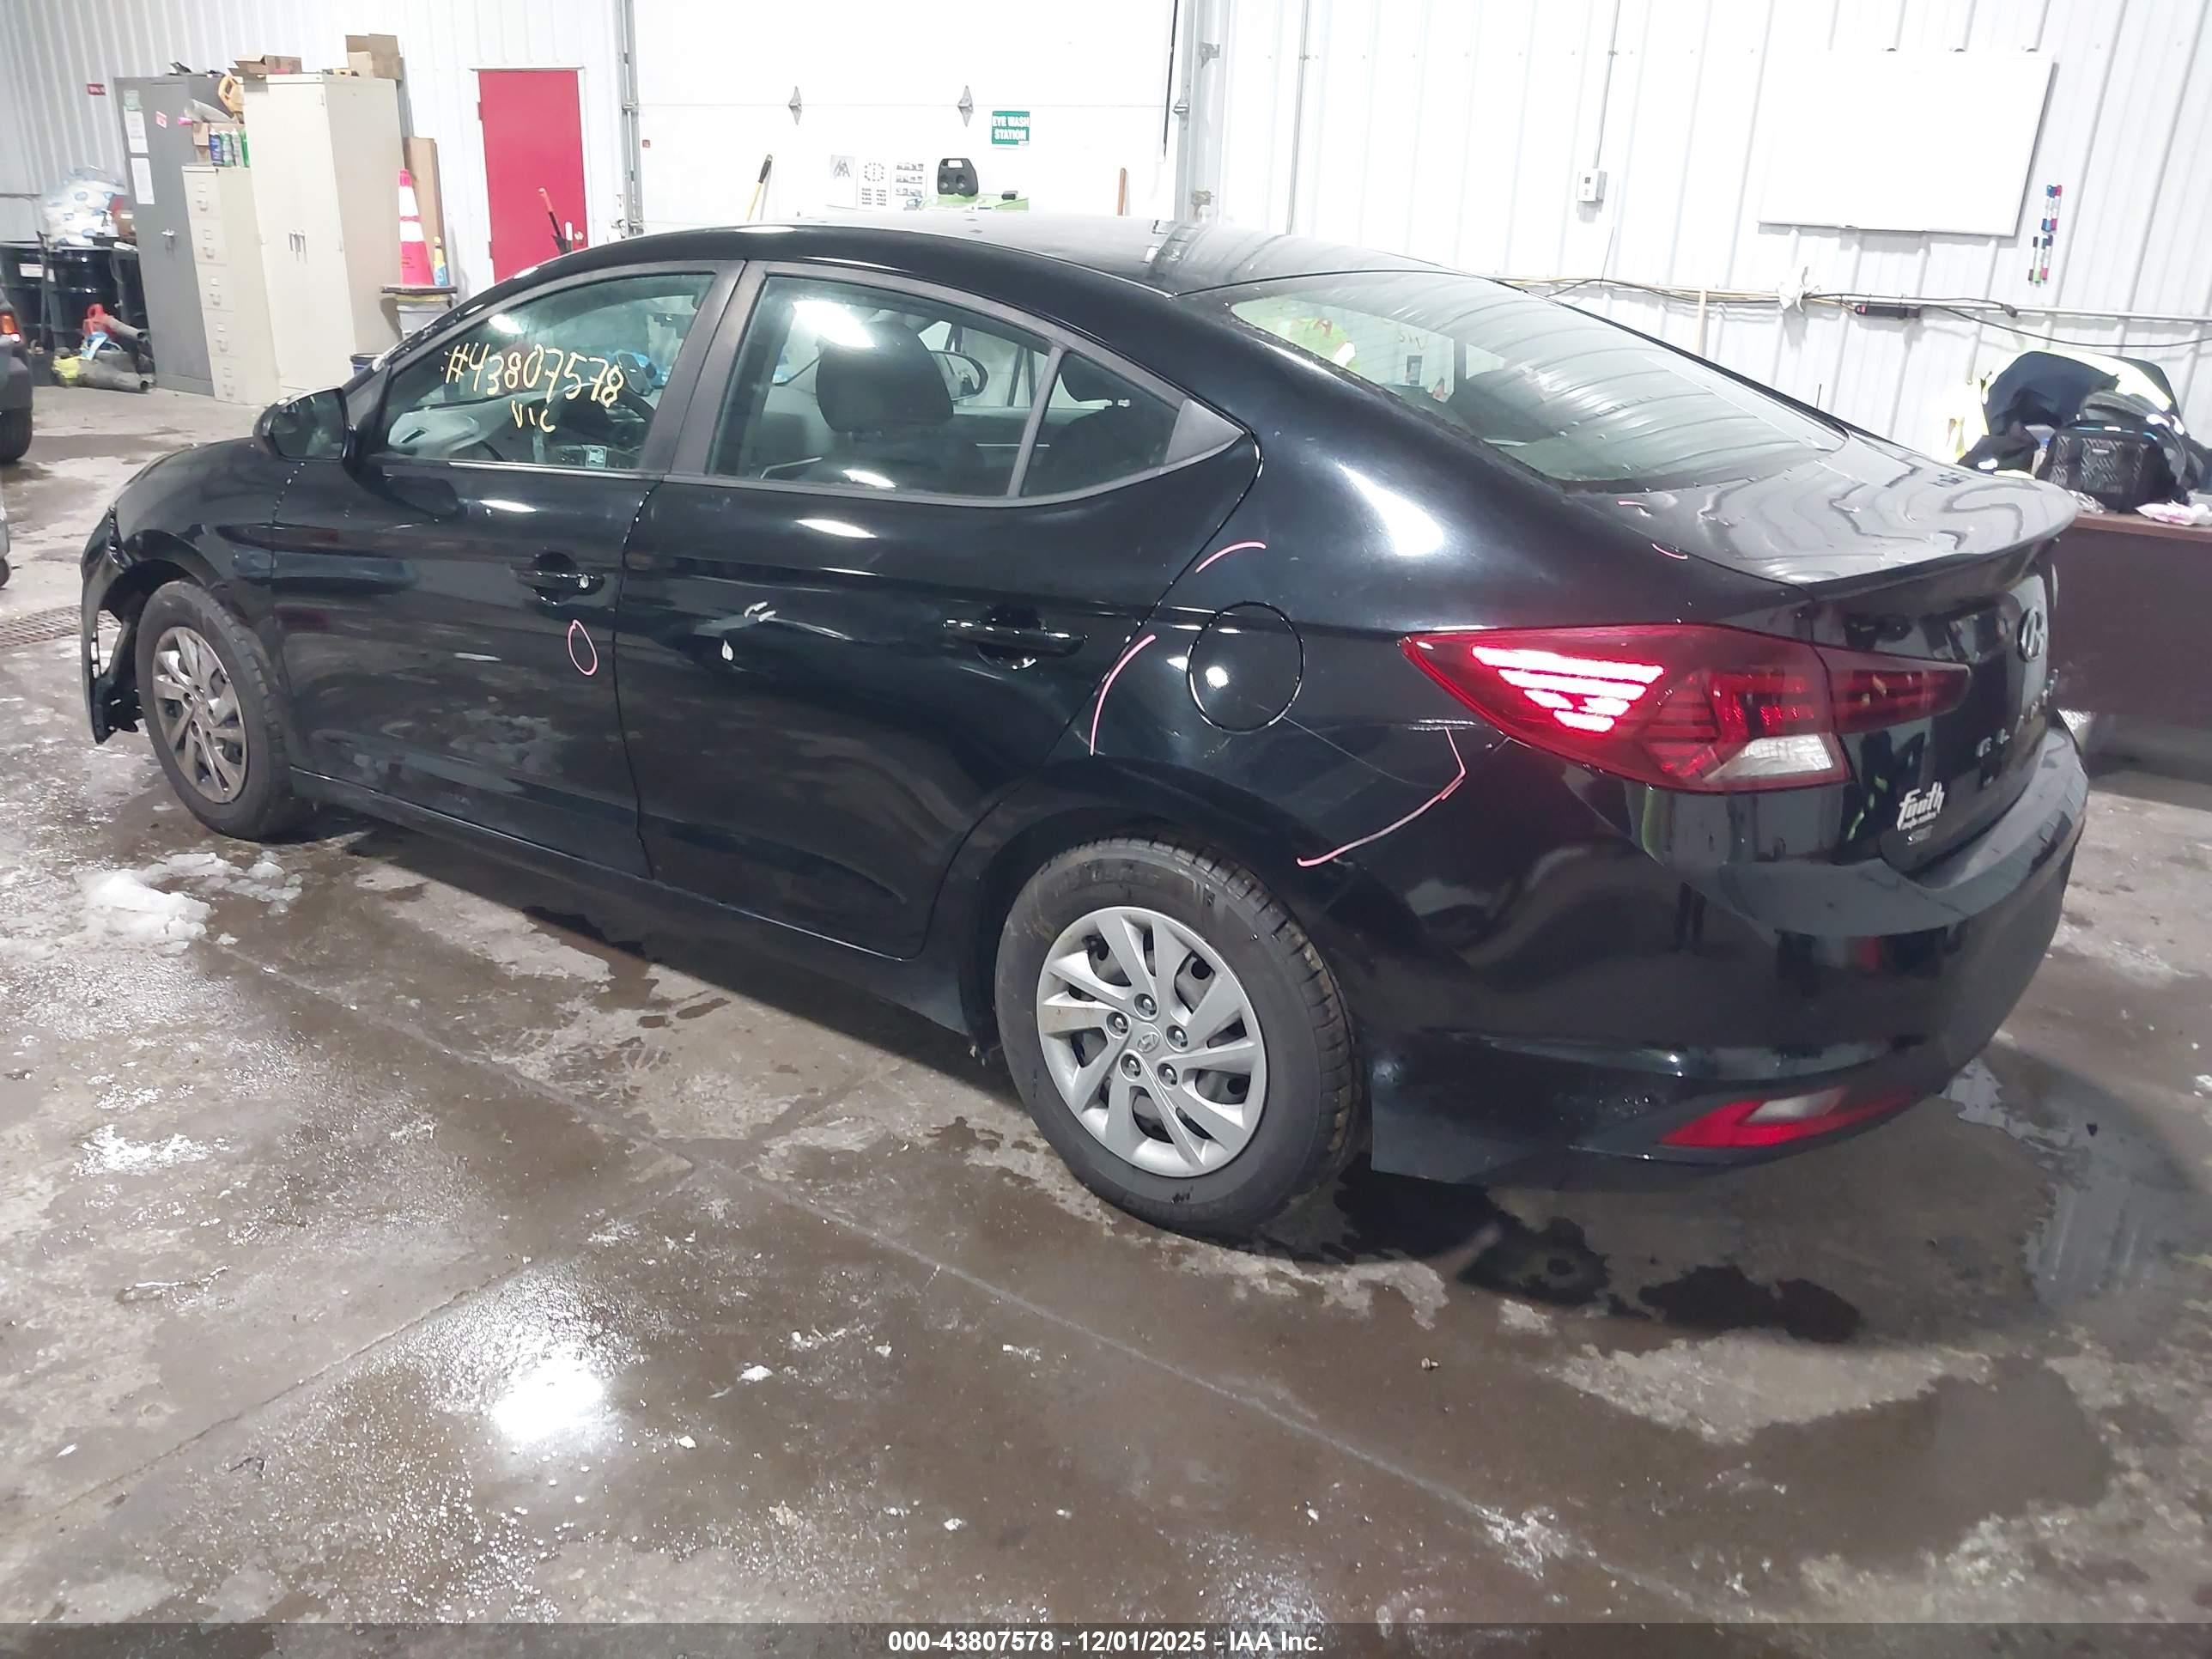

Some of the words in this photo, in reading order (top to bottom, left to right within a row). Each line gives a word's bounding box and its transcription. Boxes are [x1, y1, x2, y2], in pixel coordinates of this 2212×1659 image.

[992, 115, 1007, 127] EYE
[1007, 115, 1030, 128] WASH
[994, 128, 1027, 140] STATION
[442, 343, 625, 408] #43807578
